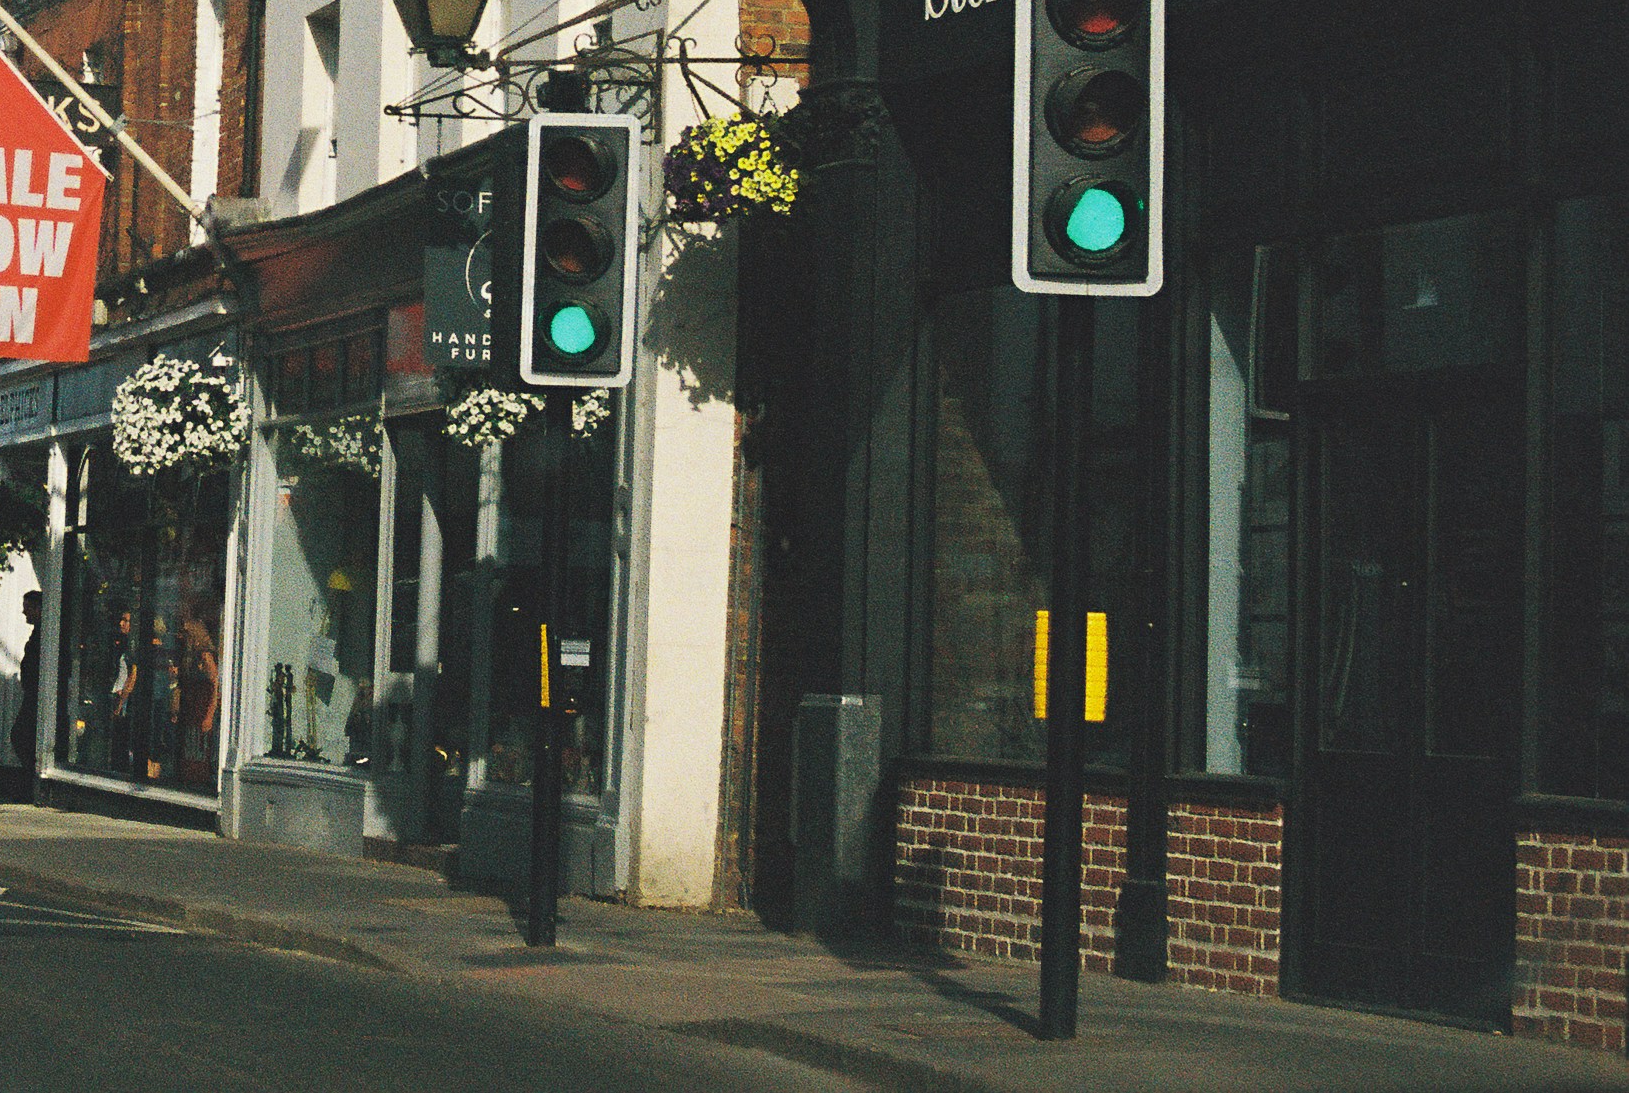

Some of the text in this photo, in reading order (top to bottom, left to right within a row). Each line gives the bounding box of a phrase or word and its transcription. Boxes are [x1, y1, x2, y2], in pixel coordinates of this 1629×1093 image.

[436, 190, 493, 214] SOF
[432, 330, 491, 346] HAND
[451, 347, 491, 361] FUR
